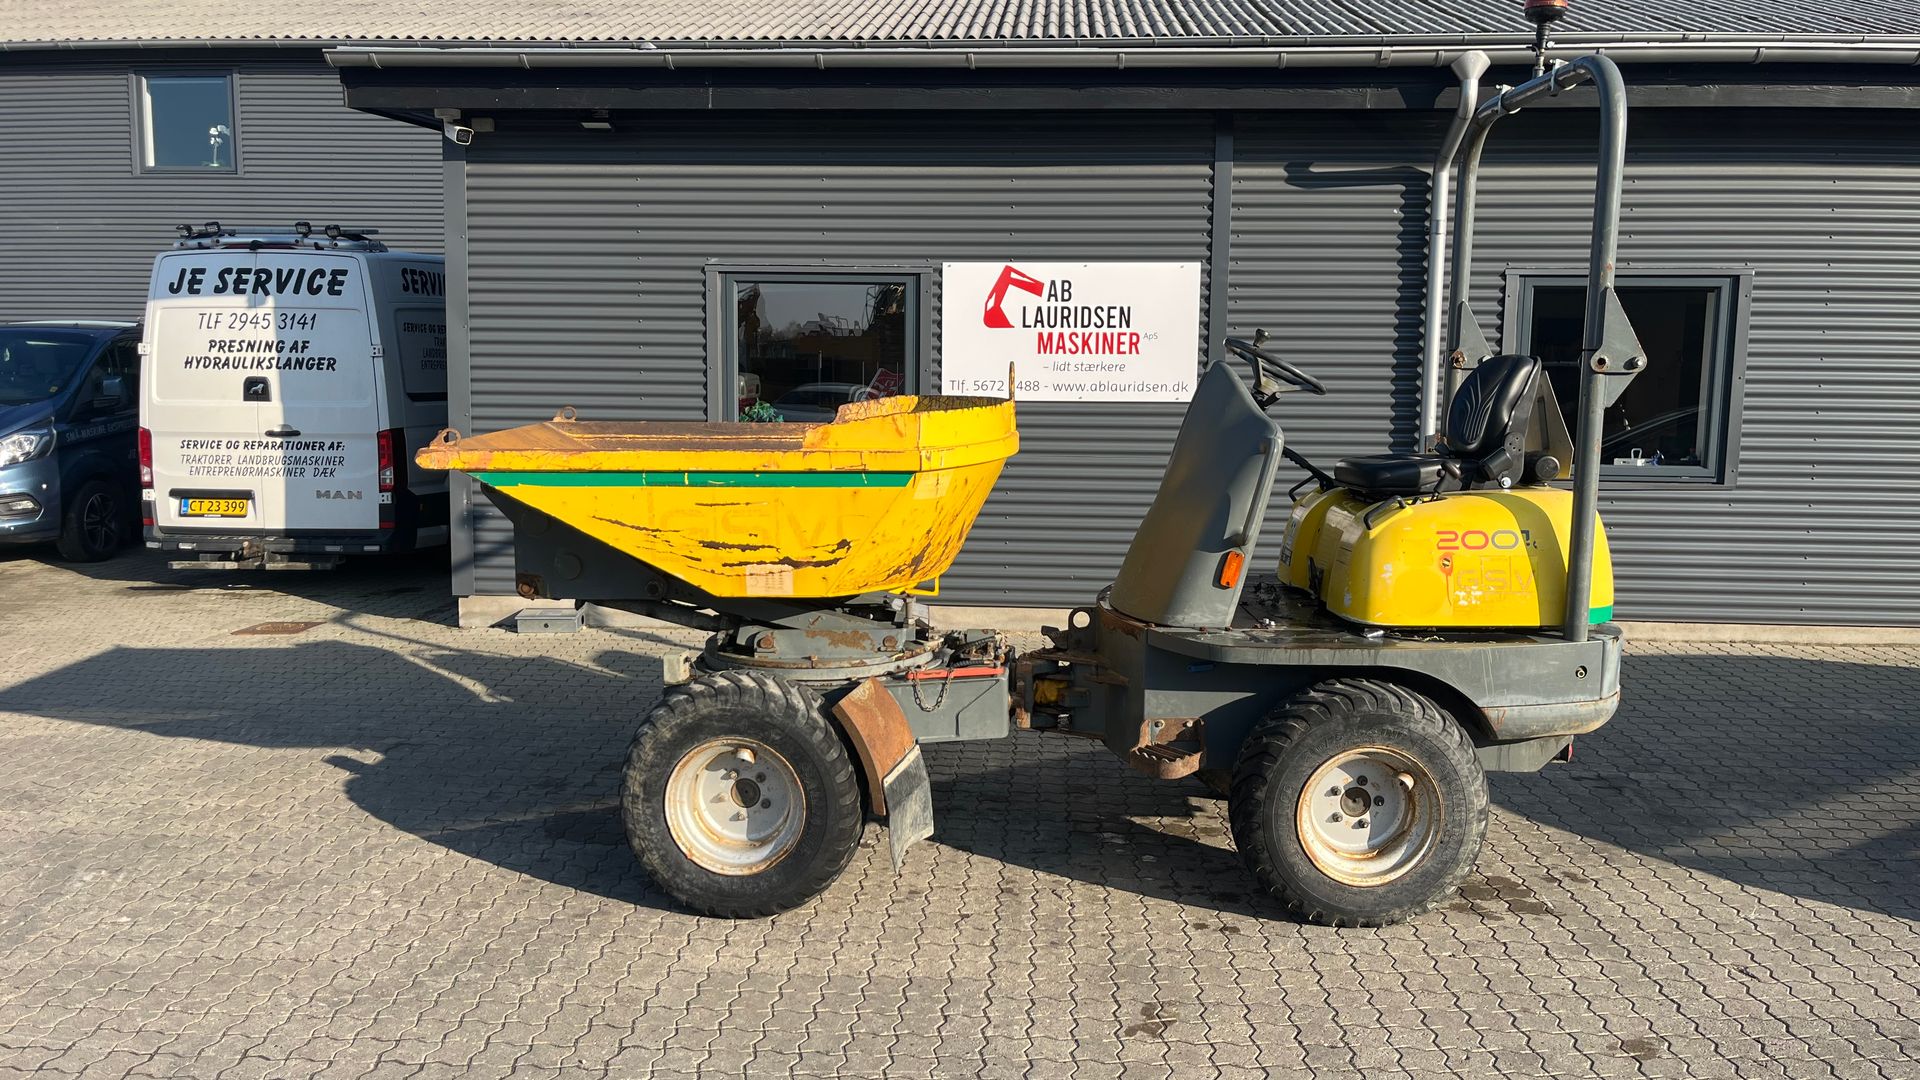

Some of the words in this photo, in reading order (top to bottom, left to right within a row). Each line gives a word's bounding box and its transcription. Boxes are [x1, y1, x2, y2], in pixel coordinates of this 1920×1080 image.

[168, 267, 206, 295] JE
[213, 267, 349, 297] SERVICE
[402, 267, 445, 297] SERVI
[1047, 280, 1072, 302] AB
[198, 313, 223, 330] TLF
[228, 313, 272, 330] 2945
[278, 313, 317, 330] 3141
[1022, 306, 1131, 328] LAURIDSEN
[208, 340, 285, 353] PRESNING
[289, 340, 310, 353] AF
[1037, 332, 1140, 355] MASKINER
[184, 356, 337, 371] HYDRAULIKSLANGER
[1052, 361, 1071, 372] lidt
[1074, 361, 1126, 373] stærkere
[949, 380, 969, 392] Tlf.
[973, 380, 1005, 392] 5672
[1009, 380, 1040, 393] 488
[1052, 382, 1189, 393] www.ablauridsen.dk
[180, 440, 222, 451] SERVICE
[225, 440, 240, 451] OG
[243, 440, 326, 452] REPARATIONER
[327, 442, 346, 452] AF:
[180, 454, 233, 466] TRAKTORER
[237, 455, 345, 467] LANDBRUGSMASKINER
[189, 466, 306, 478] ENTREPRENØRMASKINER
[312, 467, 336, 478] DÆK
[316, 490, 363, 500] MAN
[189, 500, 205, 513] CT
[207, 500, 221, 512] 23
[223, 500, 245, 513] 399
